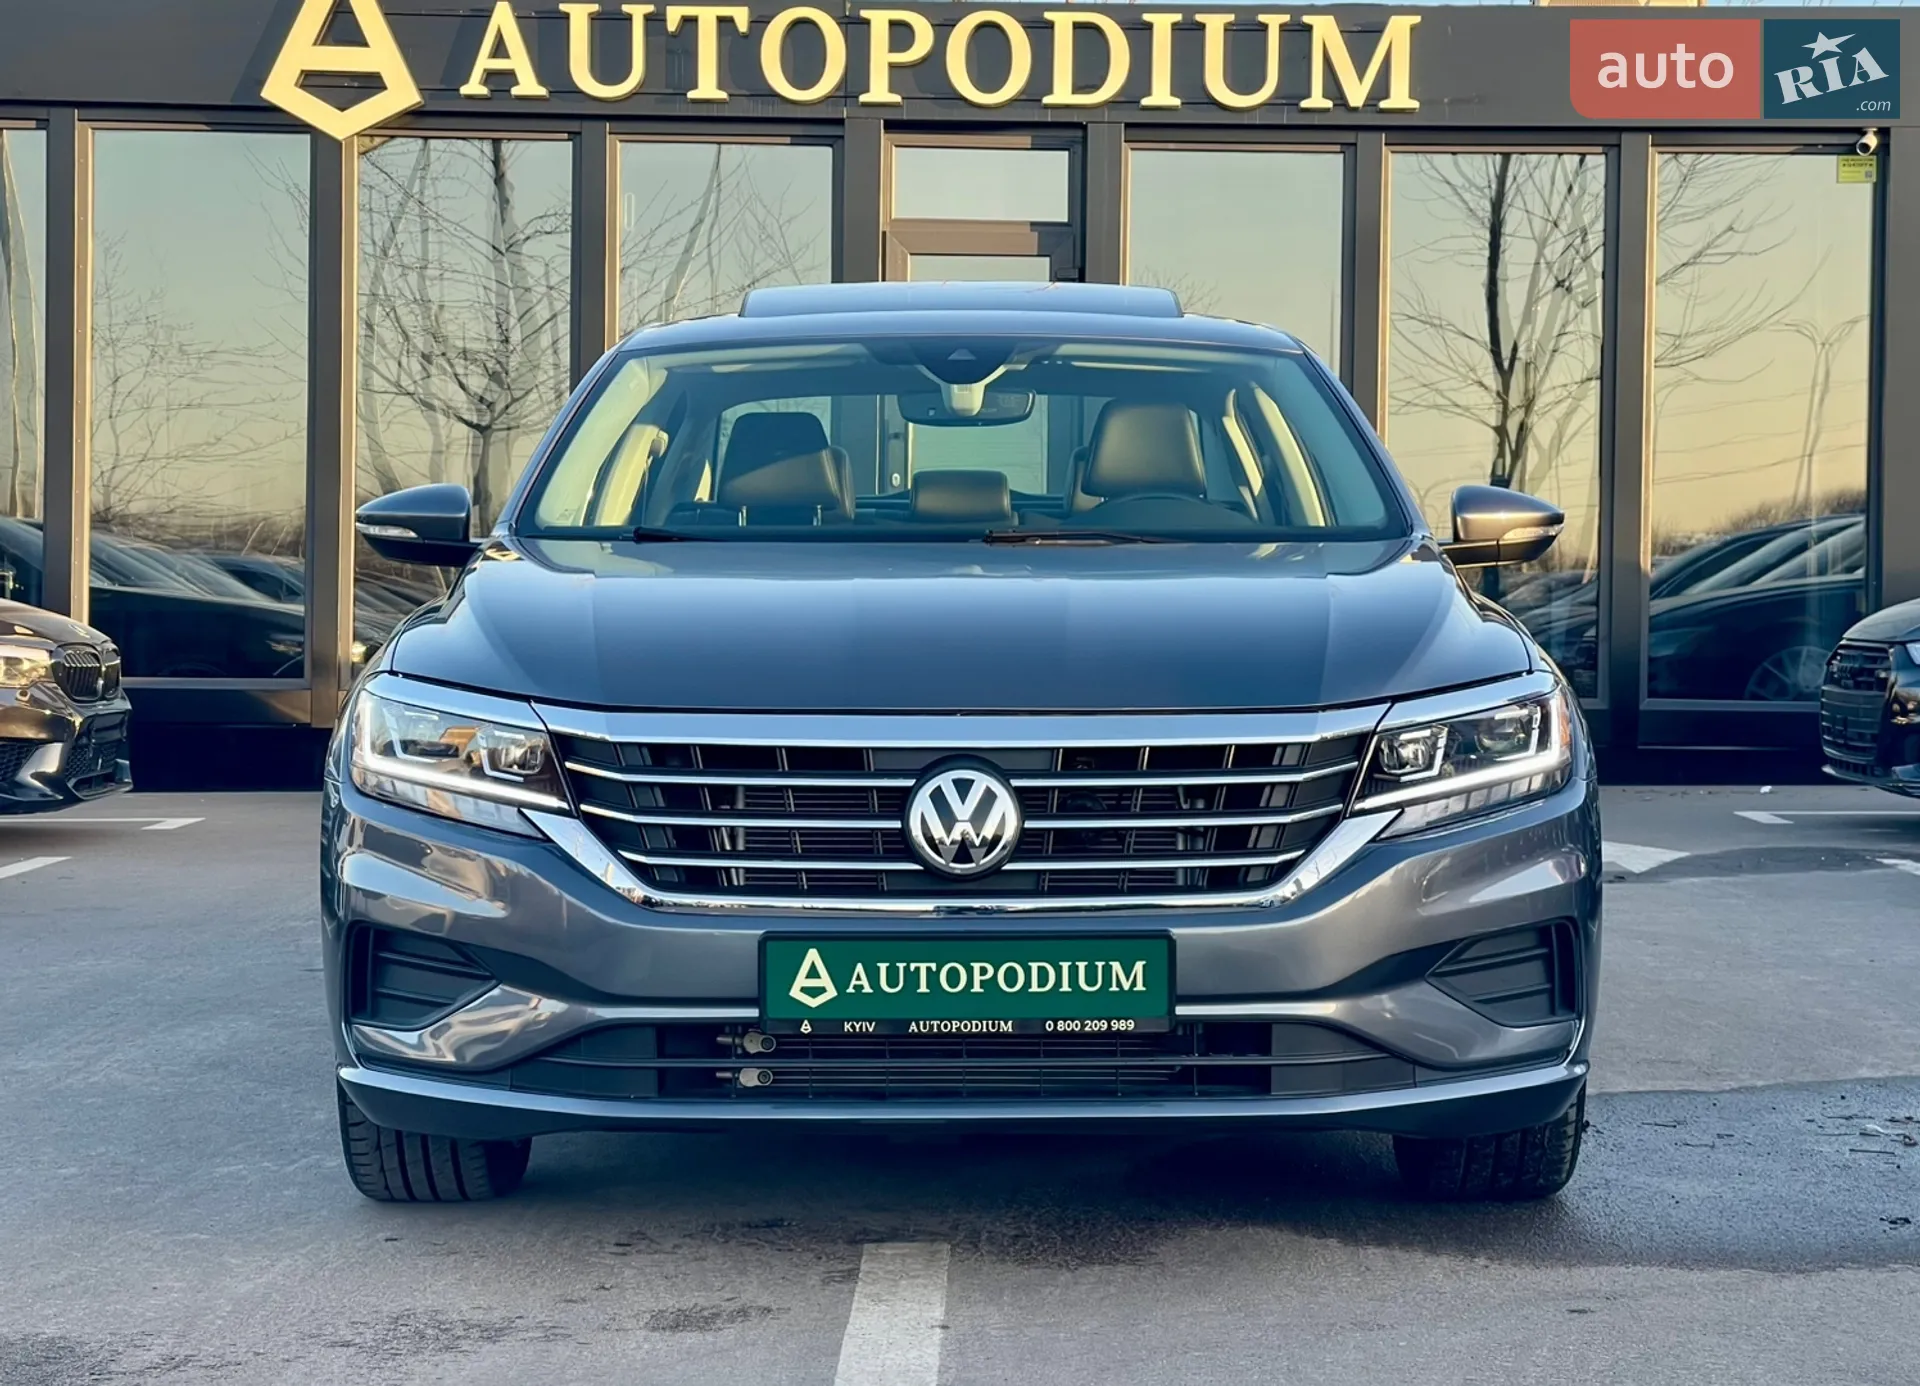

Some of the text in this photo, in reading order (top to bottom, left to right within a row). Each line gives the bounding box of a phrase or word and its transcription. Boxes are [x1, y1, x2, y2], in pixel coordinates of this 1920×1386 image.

[459, 1, 1421, 112] AUTOPODIUM
[846, 960, 1148, 994] AUTOPODIUM
[843, 1019, 1135, 1033] KYIV AUTOPODIUM 0 800 209 989
